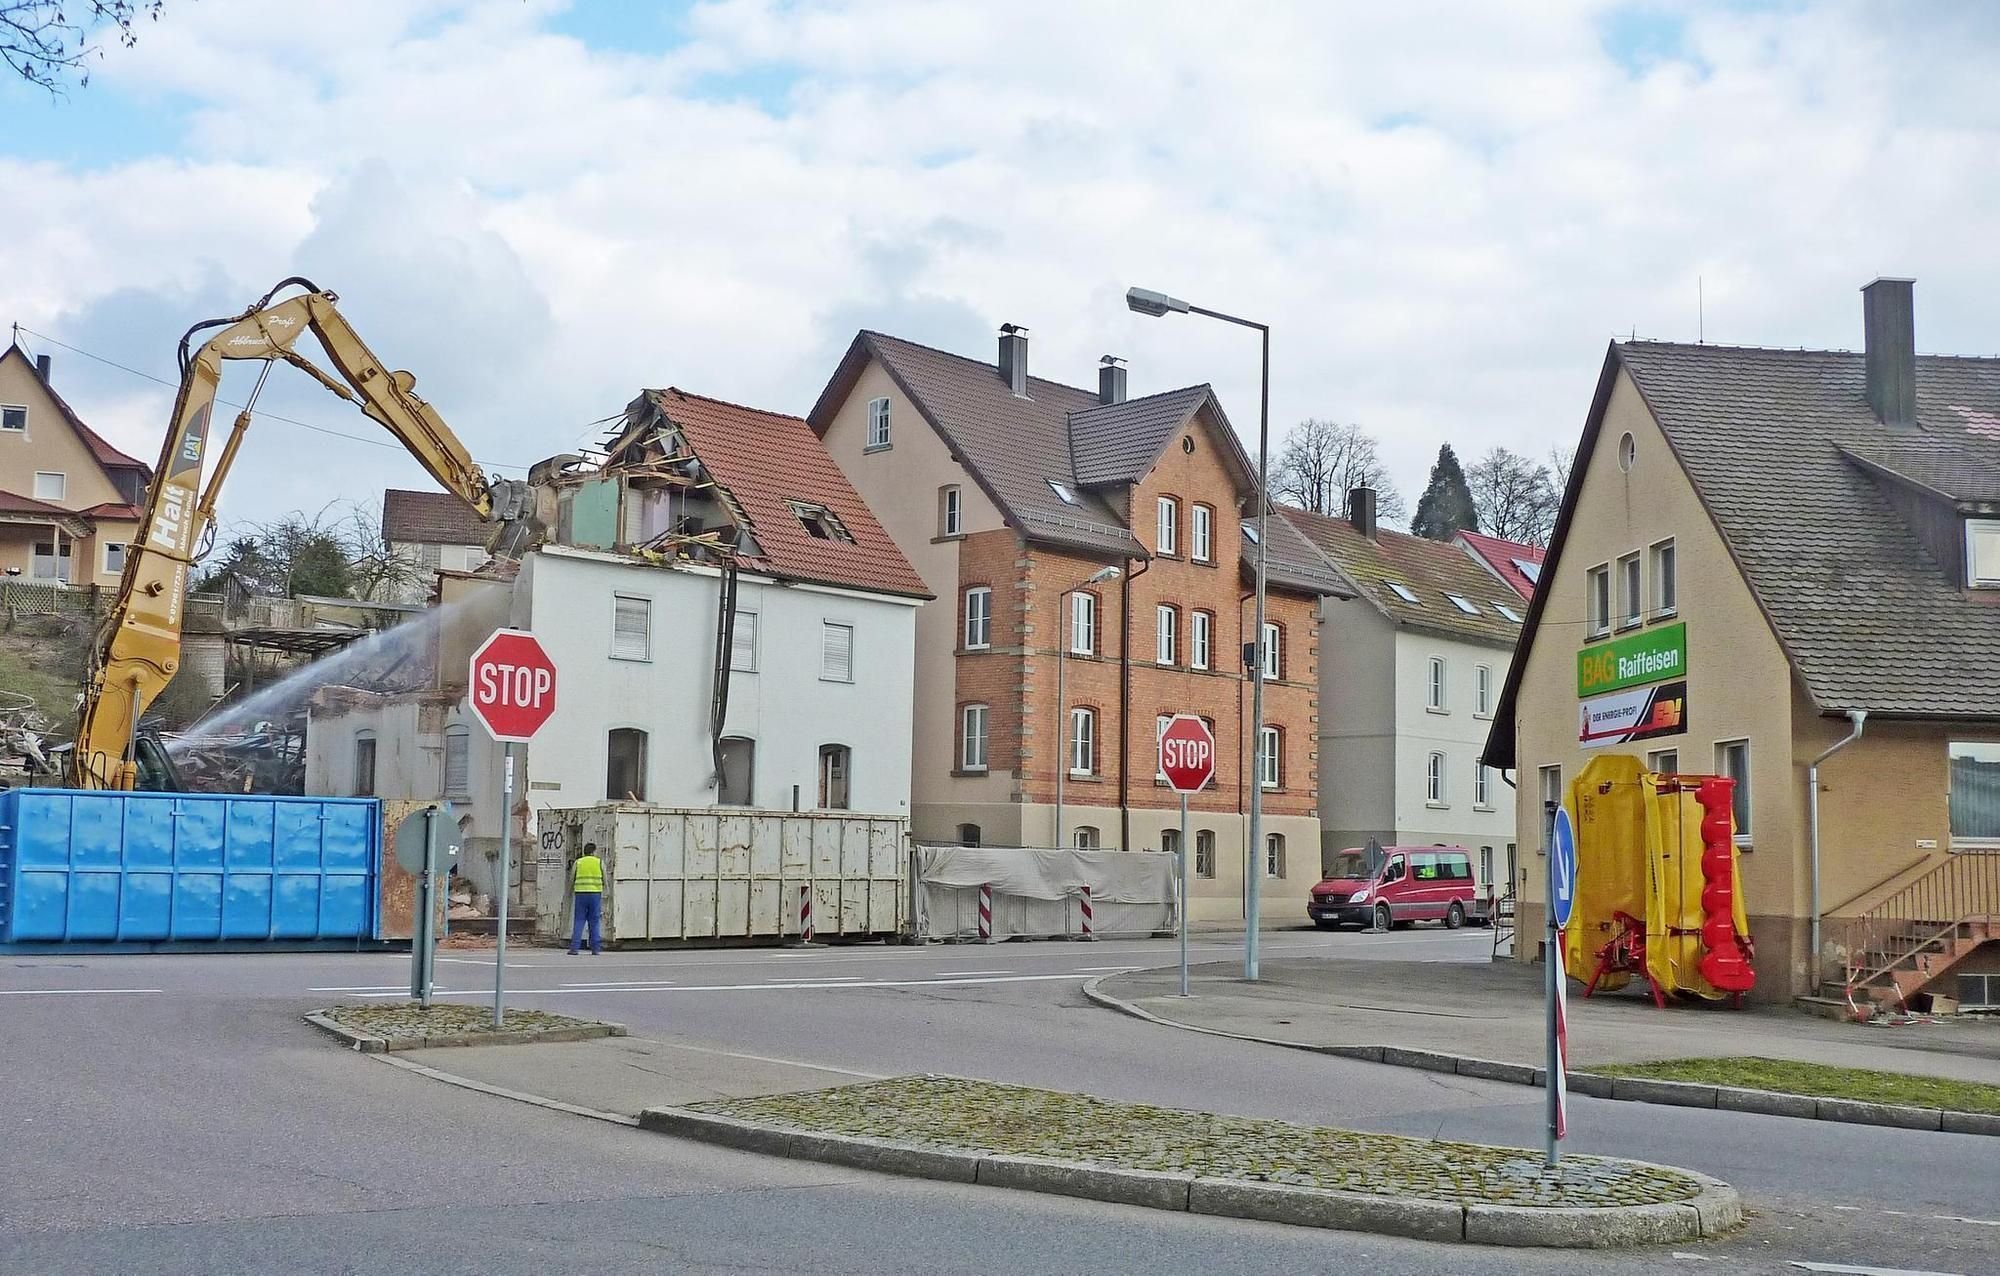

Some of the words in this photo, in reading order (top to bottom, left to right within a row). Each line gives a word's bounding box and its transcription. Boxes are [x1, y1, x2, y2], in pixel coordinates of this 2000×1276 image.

[268, 312, 297, 328] Profi
[183, 432, 201, 461] CAT
[151, 485, 184, 549] Halt
[179, 519, 191, 551] Abbruch
[1582, 650, 1616, 688] BAG
[1618, 648, 1679, 680] Raiffeisen
[480, 662, 551, 708] STOP
[1165, 738, 1209, 769] STOP
